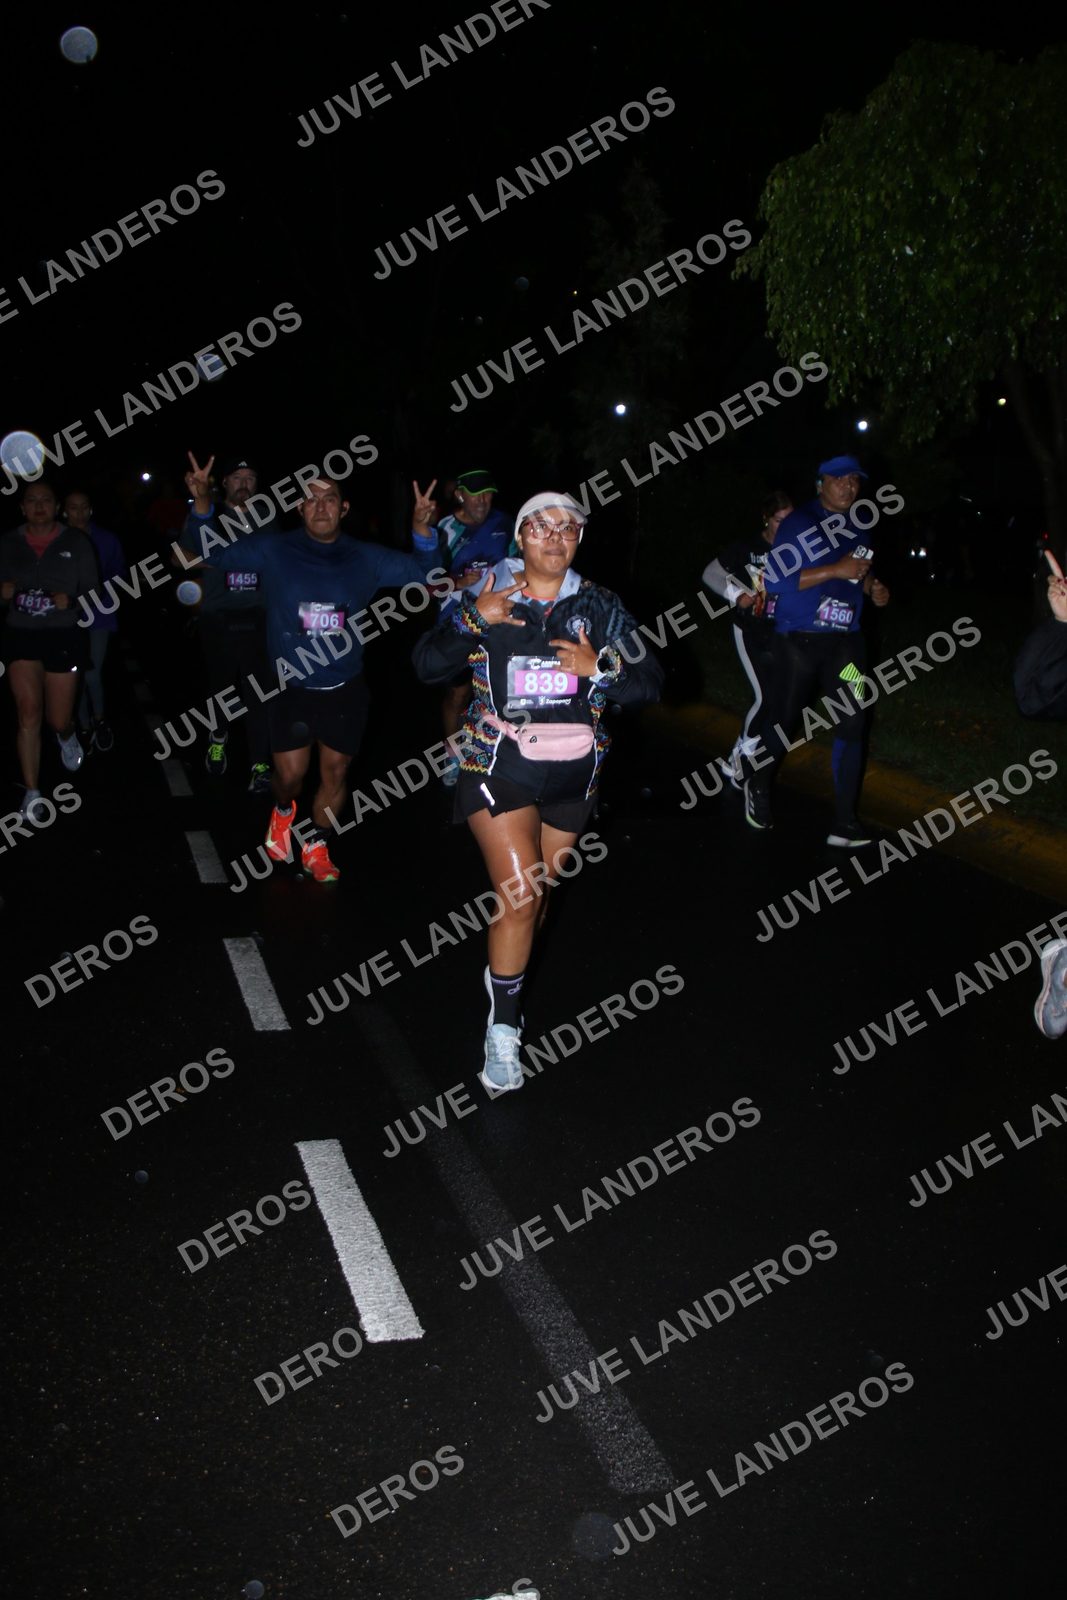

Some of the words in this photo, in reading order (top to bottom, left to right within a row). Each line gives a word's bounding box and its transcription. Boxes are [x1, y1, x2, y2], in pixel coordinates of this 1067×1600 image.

[229, 573, 257, 585] 1455
[310, 612, 339, 628] 706
[823, 606, 854, 625] 1560
[524, 672, 568, 694] 839
